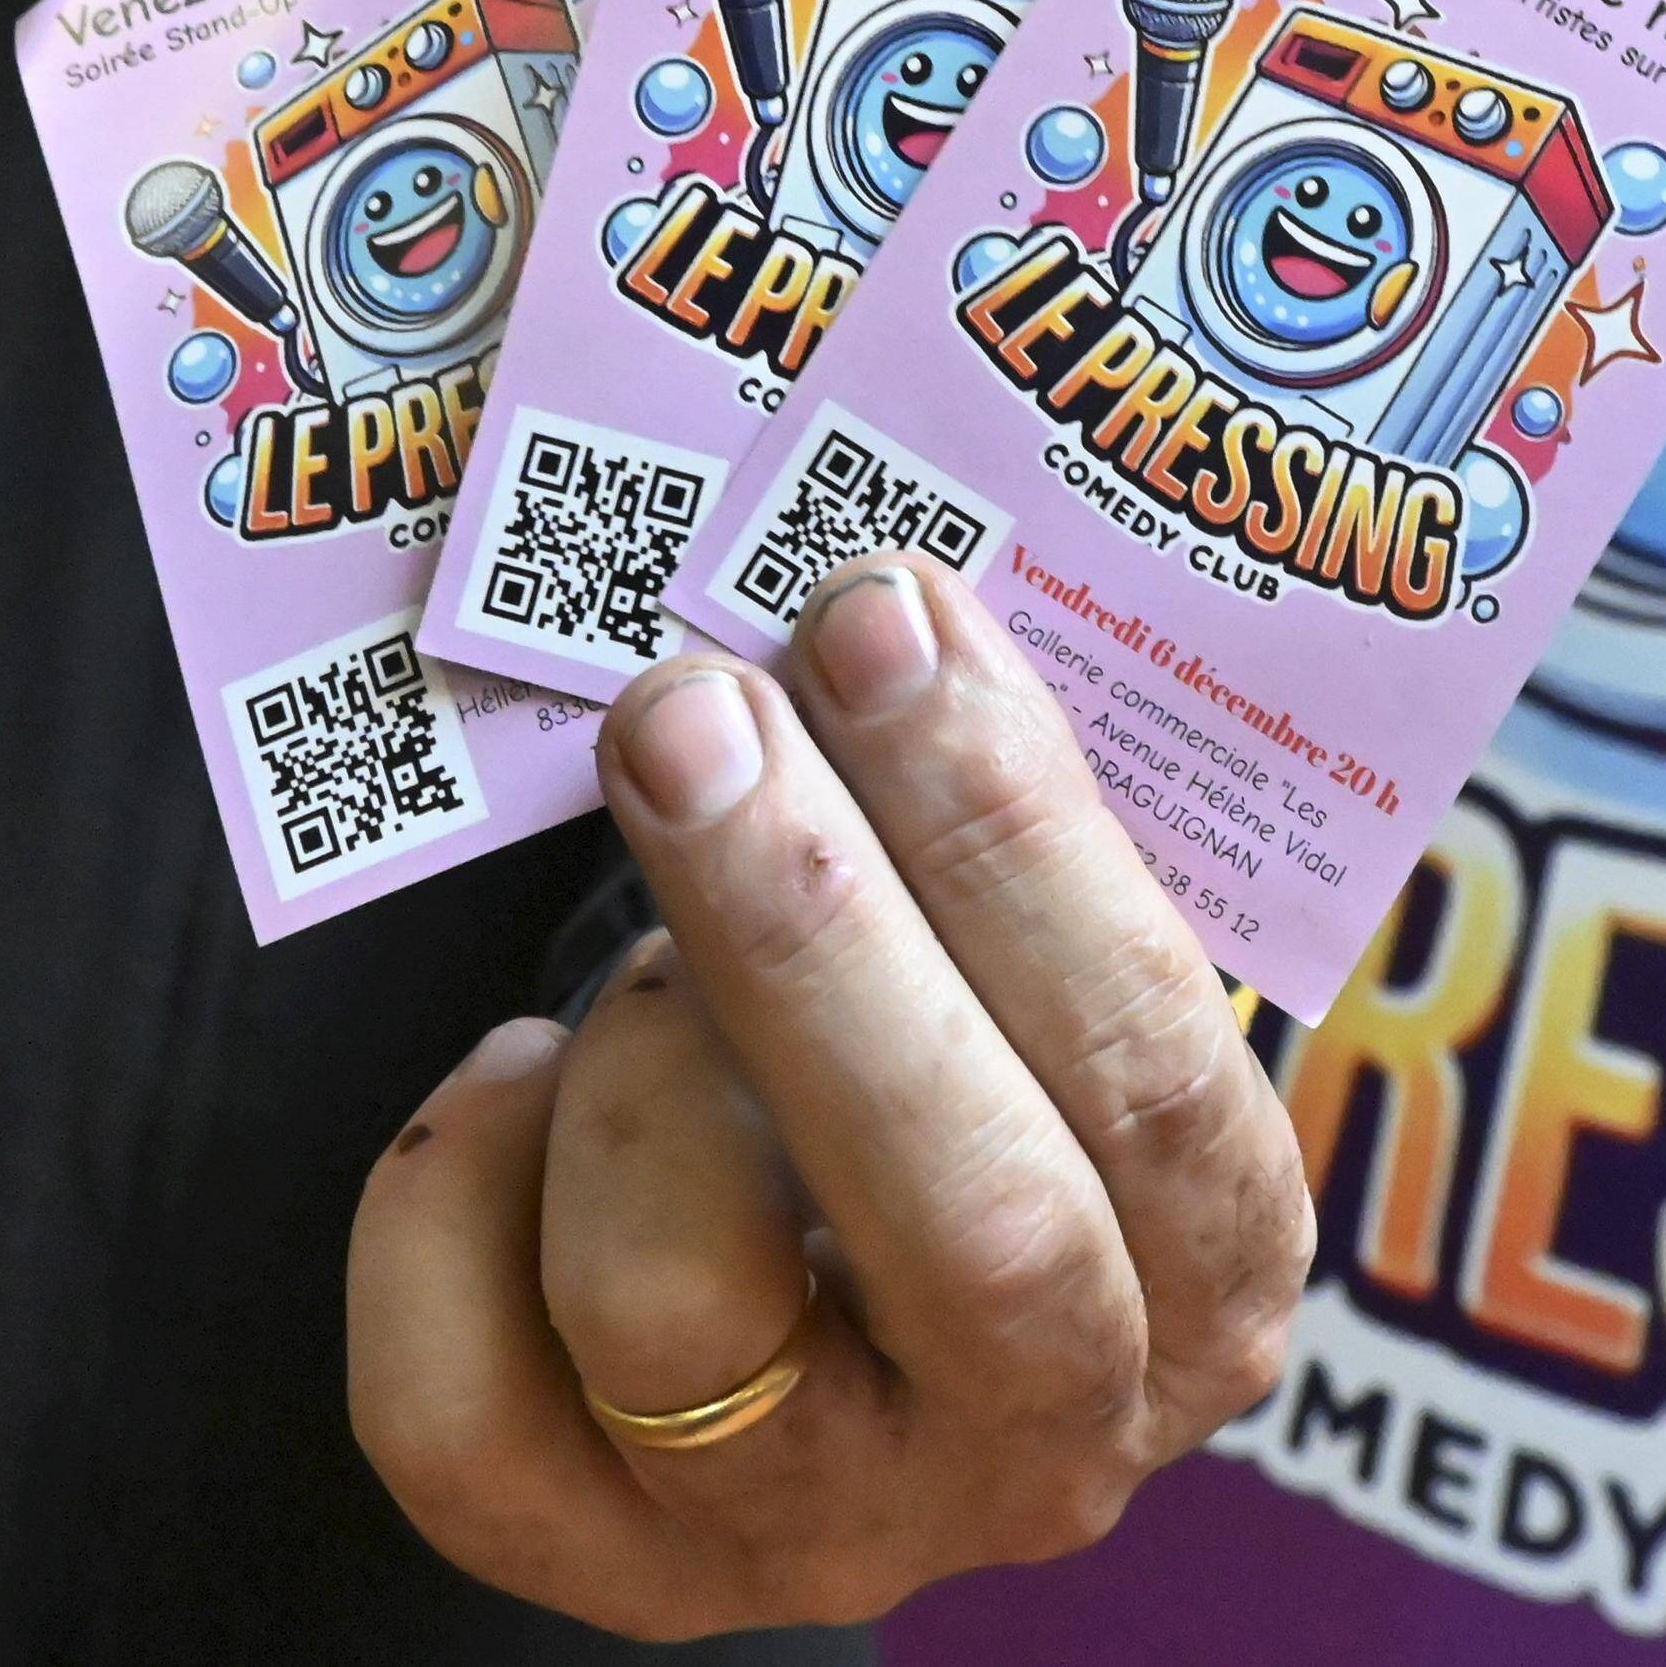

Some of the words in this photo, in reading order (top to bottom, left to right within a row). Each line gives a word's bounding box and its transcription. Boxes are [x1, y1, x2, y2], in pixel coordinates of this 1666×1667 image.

[65, 39, 156, 90] Soirée
[625, 185, 758, 331] LE
[247, 406, 335, 533] LE
[965, 240, 1113, 382] LE
[1047, 312, 1458, 615] PRESSING
[1042, 442, 1182, 551] COMEDY
[1189, 544, 1280, 602] CLUB
[1008, 609, 1105, 685] Gallerie
[1109, 680, 1270, 792] commerciale
[1281, 779, 1328, 829] "Les
[1011, 542, 1152, 655] Vendredi
[1150, 637, 1177, 668] 6
[1173, 653, 1329, 768] décembre
[1328, 750, 1377, 797] 20
[1374, 778, 1401, 817] h
[1084, 747, 1263, 880] DRAGUIGNAN
[1088, 711, 1181, 781] Avenue
[1185, 770, 1277, 843] Hélène
[1284, 830, 1348, 887] Vidal
[1159, 864, 1192, 897] 38
[1194, 887, 1229, 920] 55
[1229, 912, 1261, 943] 12
